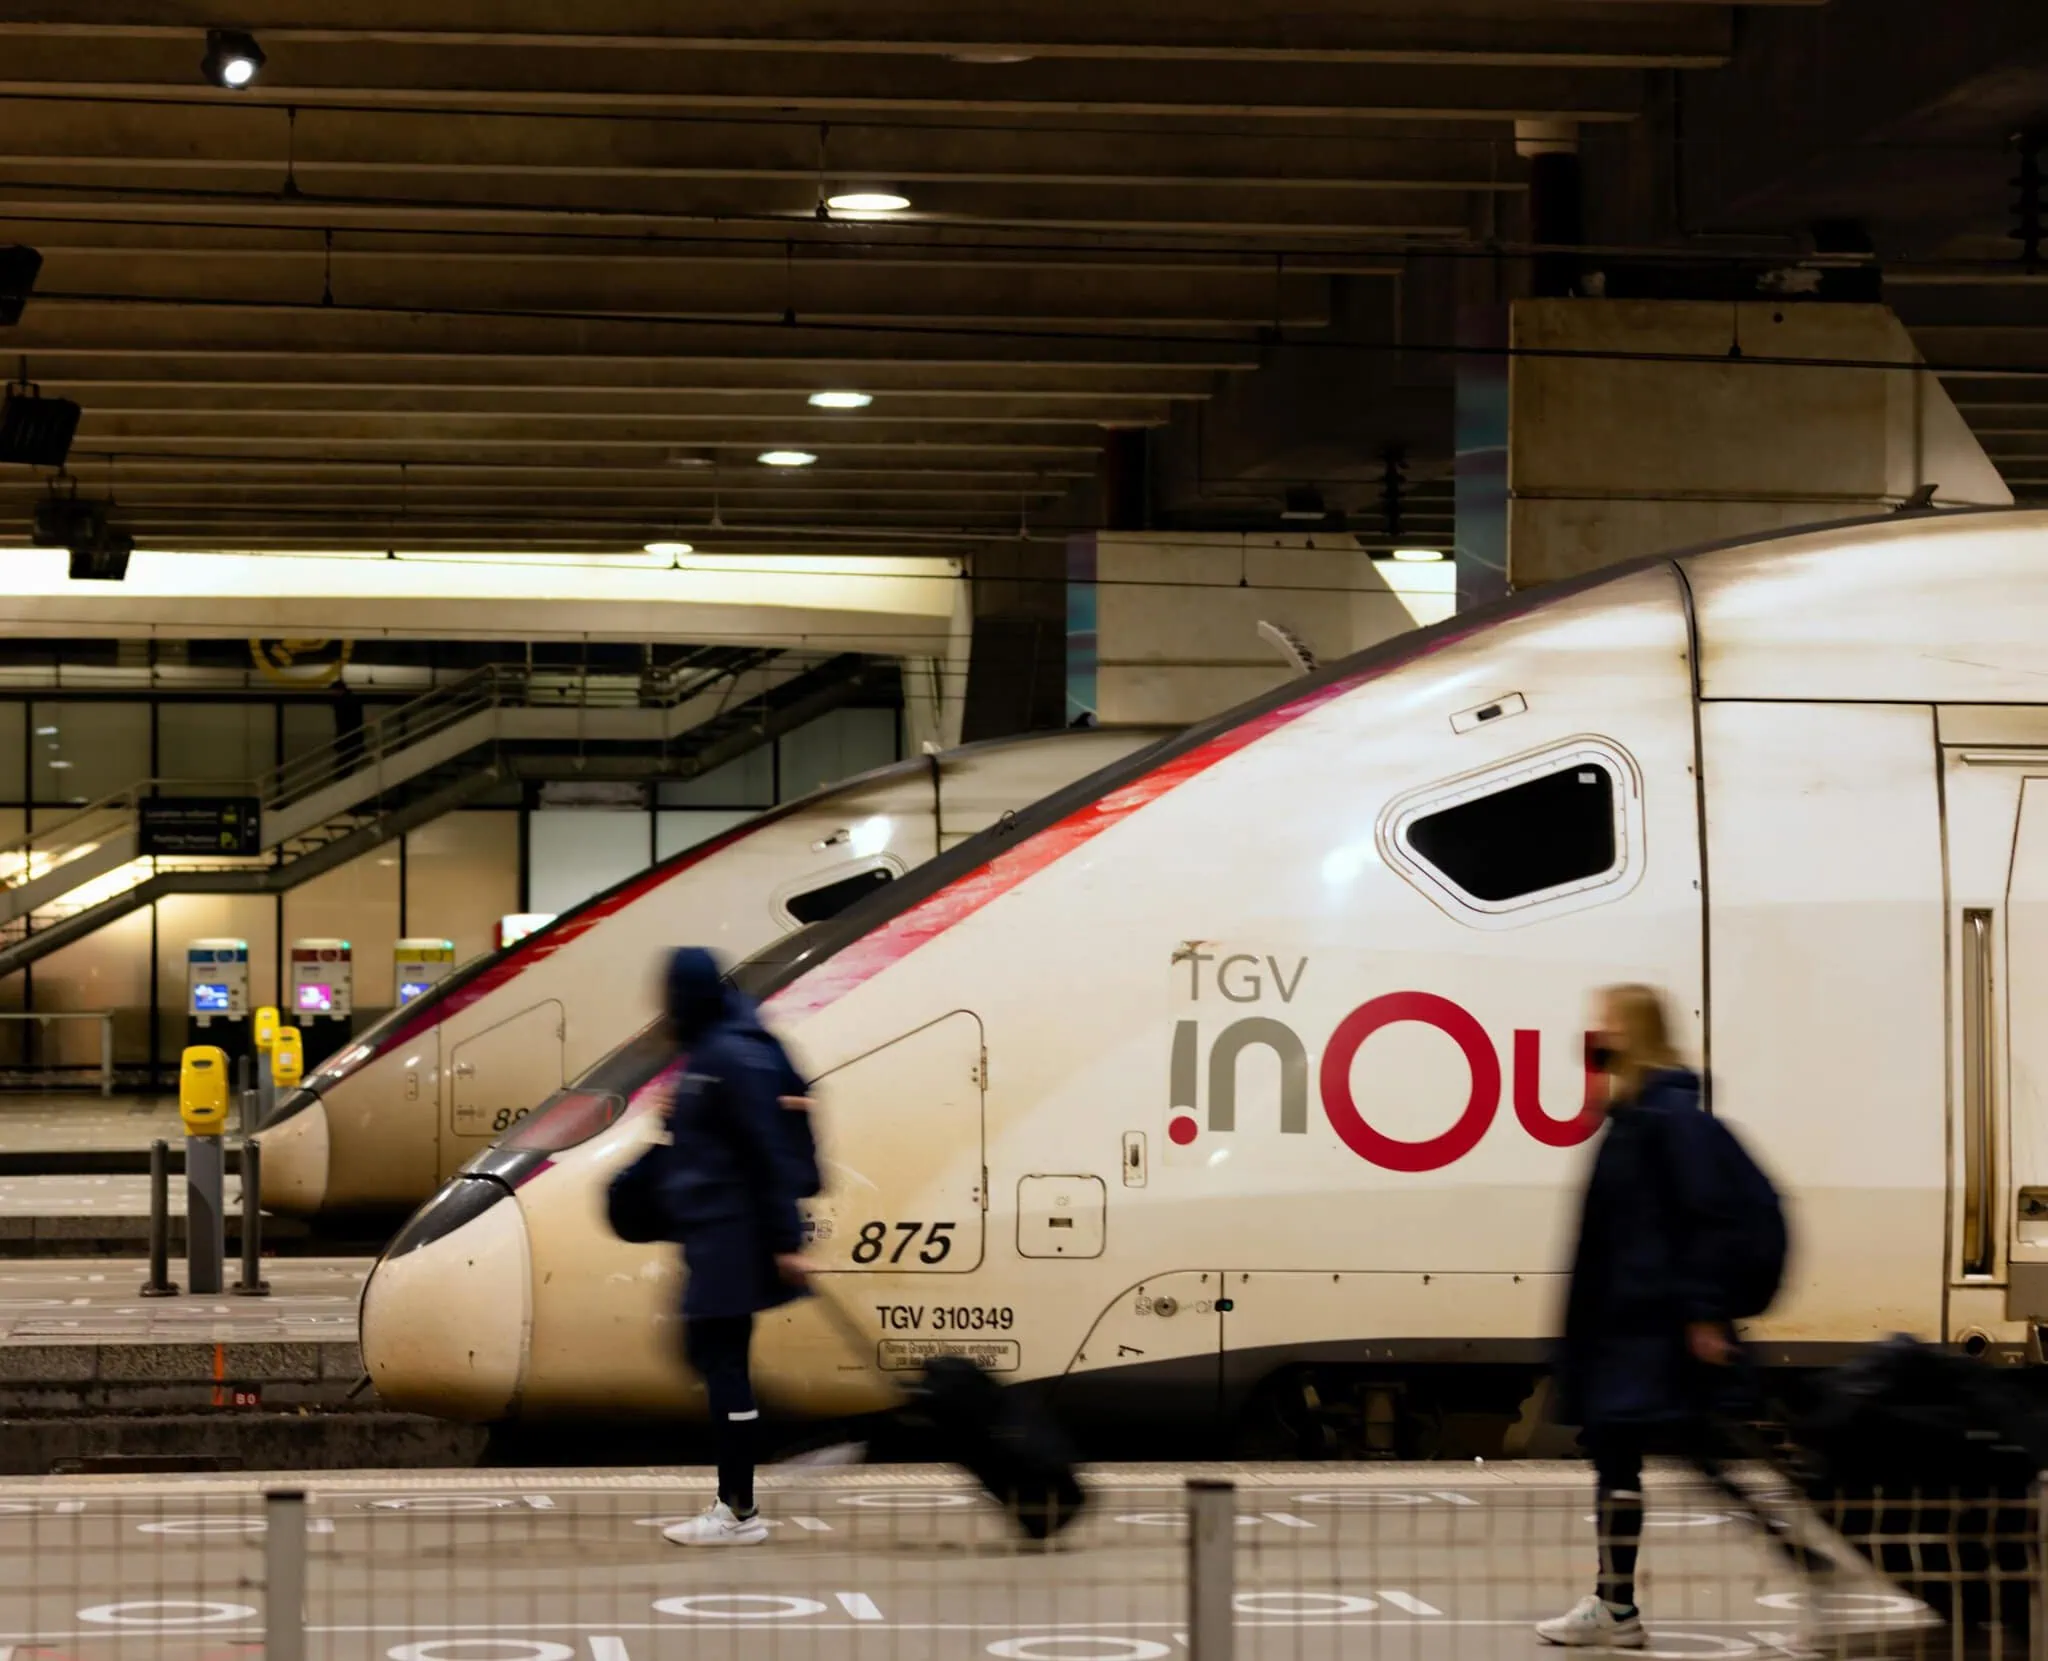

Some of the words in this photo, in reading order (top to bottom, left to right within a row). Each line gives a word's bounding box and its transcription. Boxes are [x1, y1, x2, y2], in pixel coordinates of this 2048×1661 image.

[1173, 953, 1309, 1004] TGV
[852, 1221, 956, 1264] 875
[876, 1306, 924, 1329] TGV
[932, 1307, 1014, 1330] 310349
